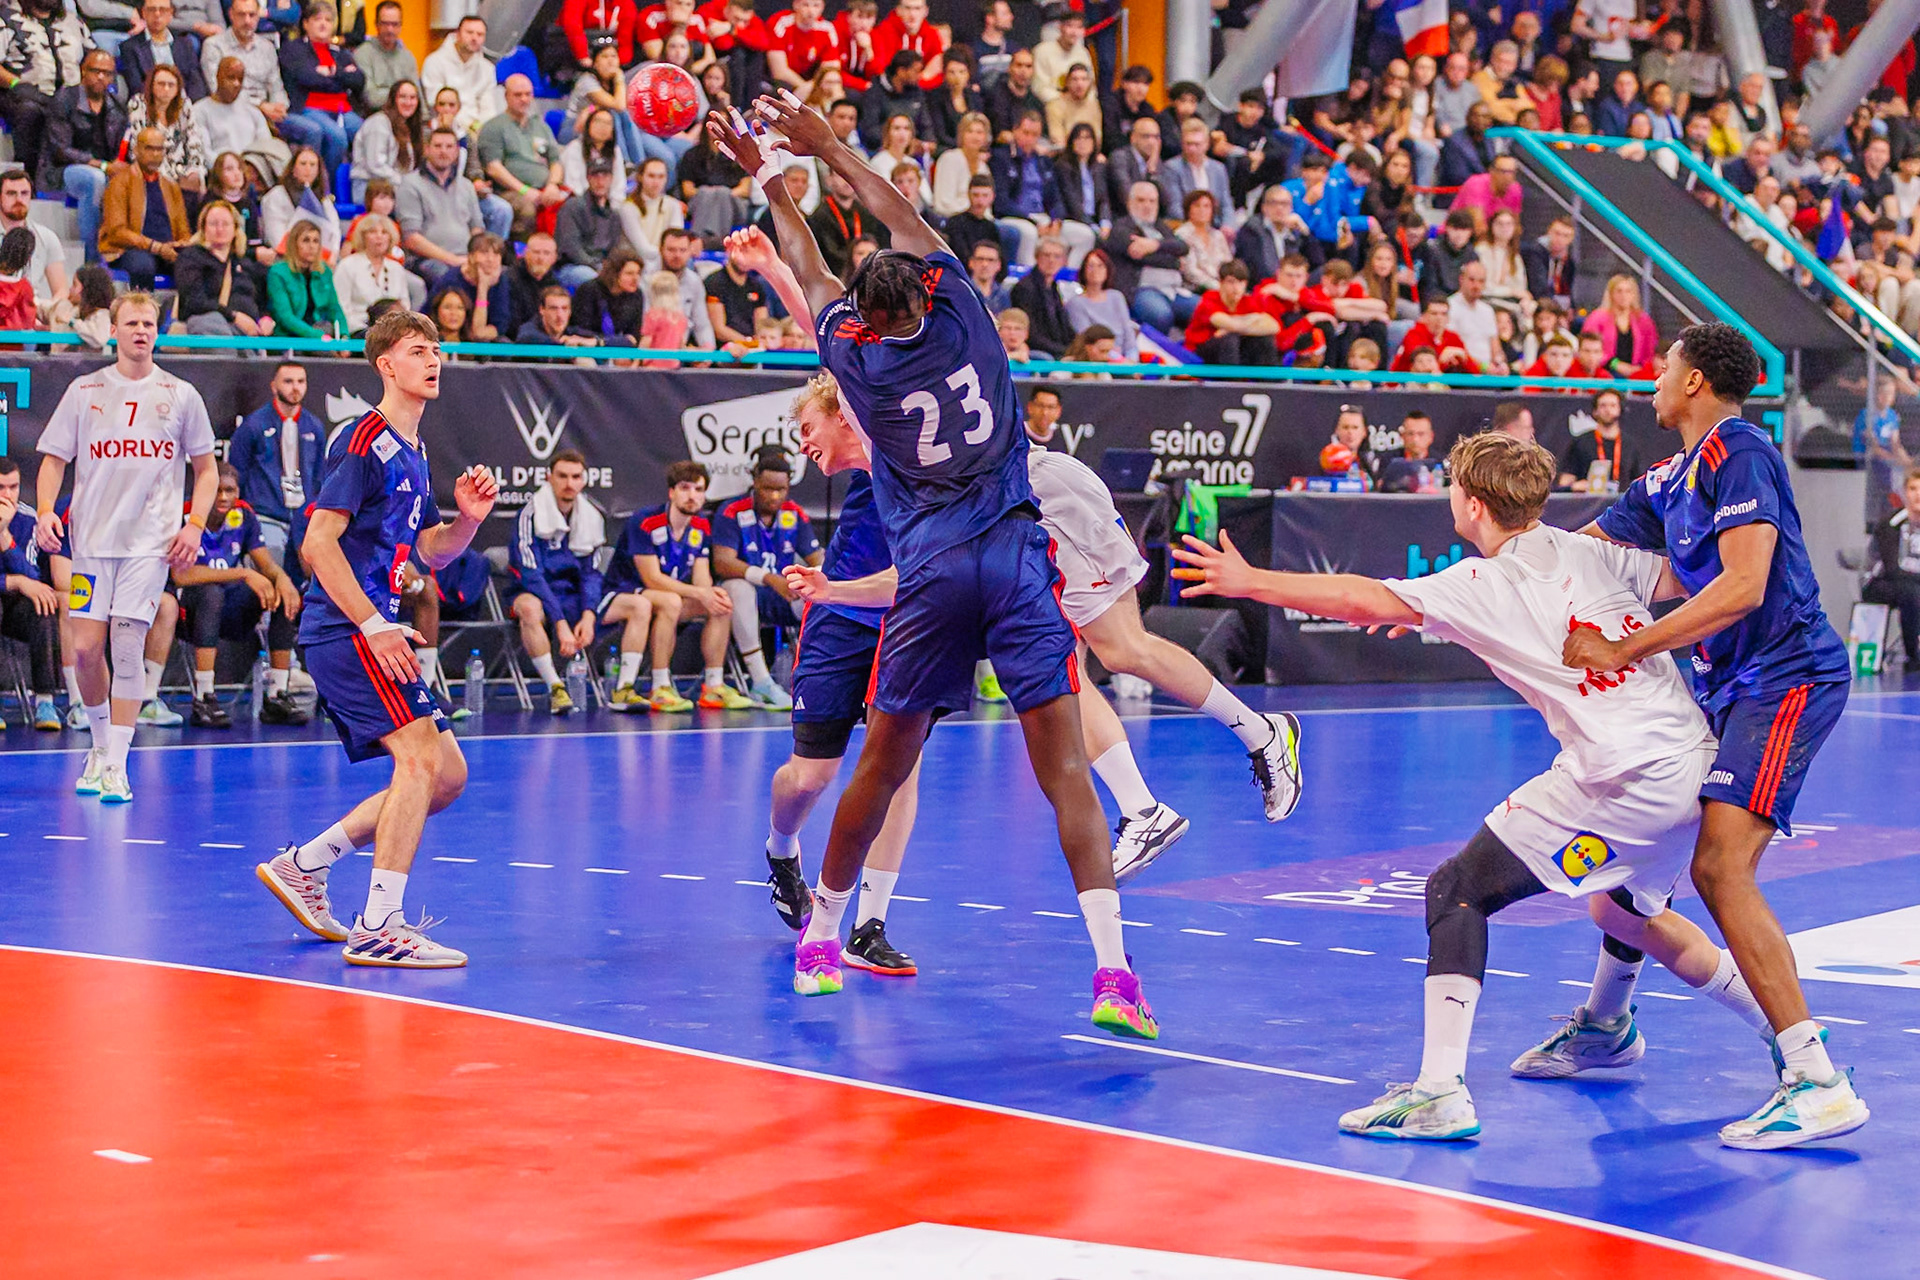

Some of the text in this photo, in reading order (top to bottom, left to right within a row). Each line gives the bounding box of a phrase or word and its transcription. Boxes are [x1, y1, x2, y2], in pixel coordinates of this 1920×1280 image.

[124, 401, 139, 428] 7
[900, 362, 995, 467] 23
[1150, 393, 1272, 457] seine 77
[89, 439, 175, 461] NORLYS
